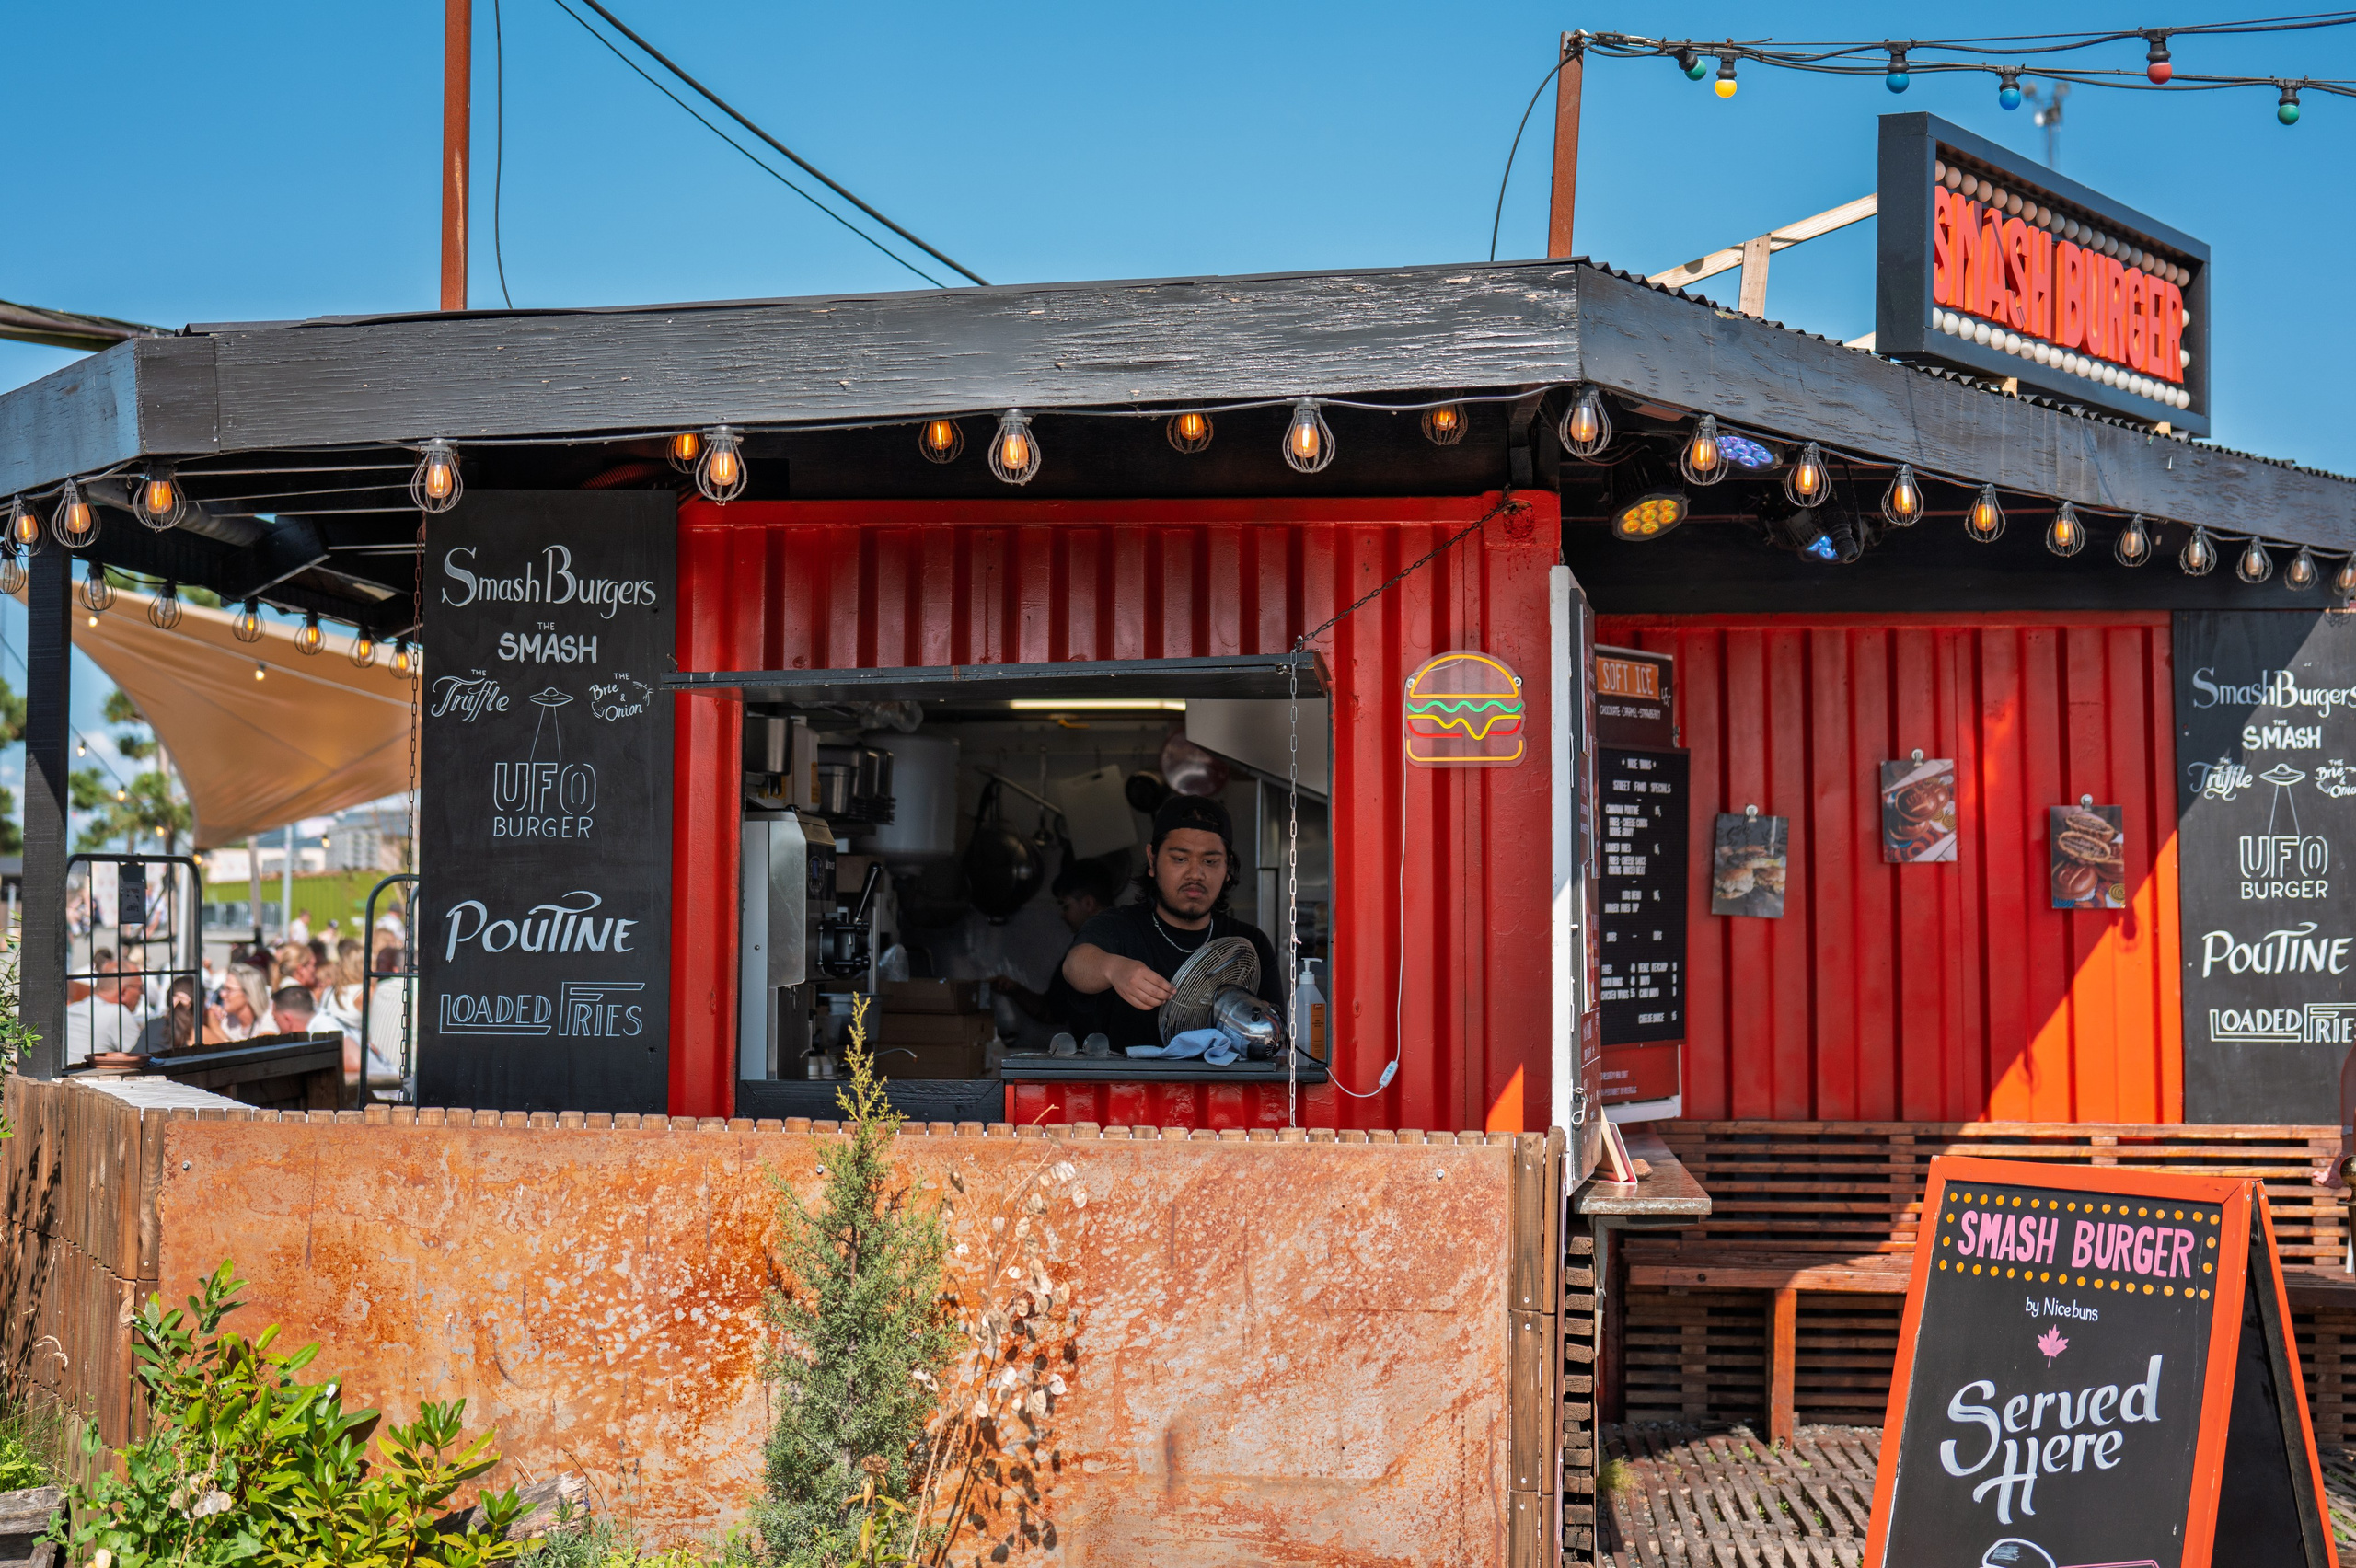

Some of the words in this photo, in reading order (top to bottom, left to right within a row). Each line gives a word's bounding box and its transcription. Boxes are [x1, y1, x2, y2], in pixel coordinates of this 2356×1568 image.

[1934, 185, 2052, 339] SMASH
[2058, 240, 2184, 384] BURGER
[442, 547, 540, 607] Smash
[543, 545, 656, 619] Burgers
[537, 622, 555, 630] THE
[498, 633, 597, 663] SMASH
[589, 684, 619, 701] Brie
[1602, 662, 1628, 692] SOFT
[1635, 665, 1654, 695] ICE
[2193, 667, 2275, 709] Smash
[431, 676, 510, 722] Truffle
[605, 703, 643, 721] Onion
[620, 694, 626, 702] &
[2242, 725, 2322, 750] SMASH
[494, 762, 597, 814] UFO
[2187, 762, 2253, 801] Truffle
[2315, 766, 2345, 781] Brie
[2329, 785, 2356, 798] Onio
[493, 817, 594, 838] BURGER
[2239, 836, 2328, 878] UFO
[2240, 880, 2328, 899] BURGER
[439, 994, 552, 1035] LOADED
[559, 982, 645, 1036] FRIES
[2209, 1009, 2302, 1043] LOADED
[2304, 1002, 2356, 1043] FRIE
[1958, 1210, 2059, 1265] SMASH
[2071, 1221, 2195, 1279] BURGER
[2025, 1296, 2040, 1318] by
[1940, 1355, 2164, 1477] Served
[1972, 1431, 2123, 1525] Here
